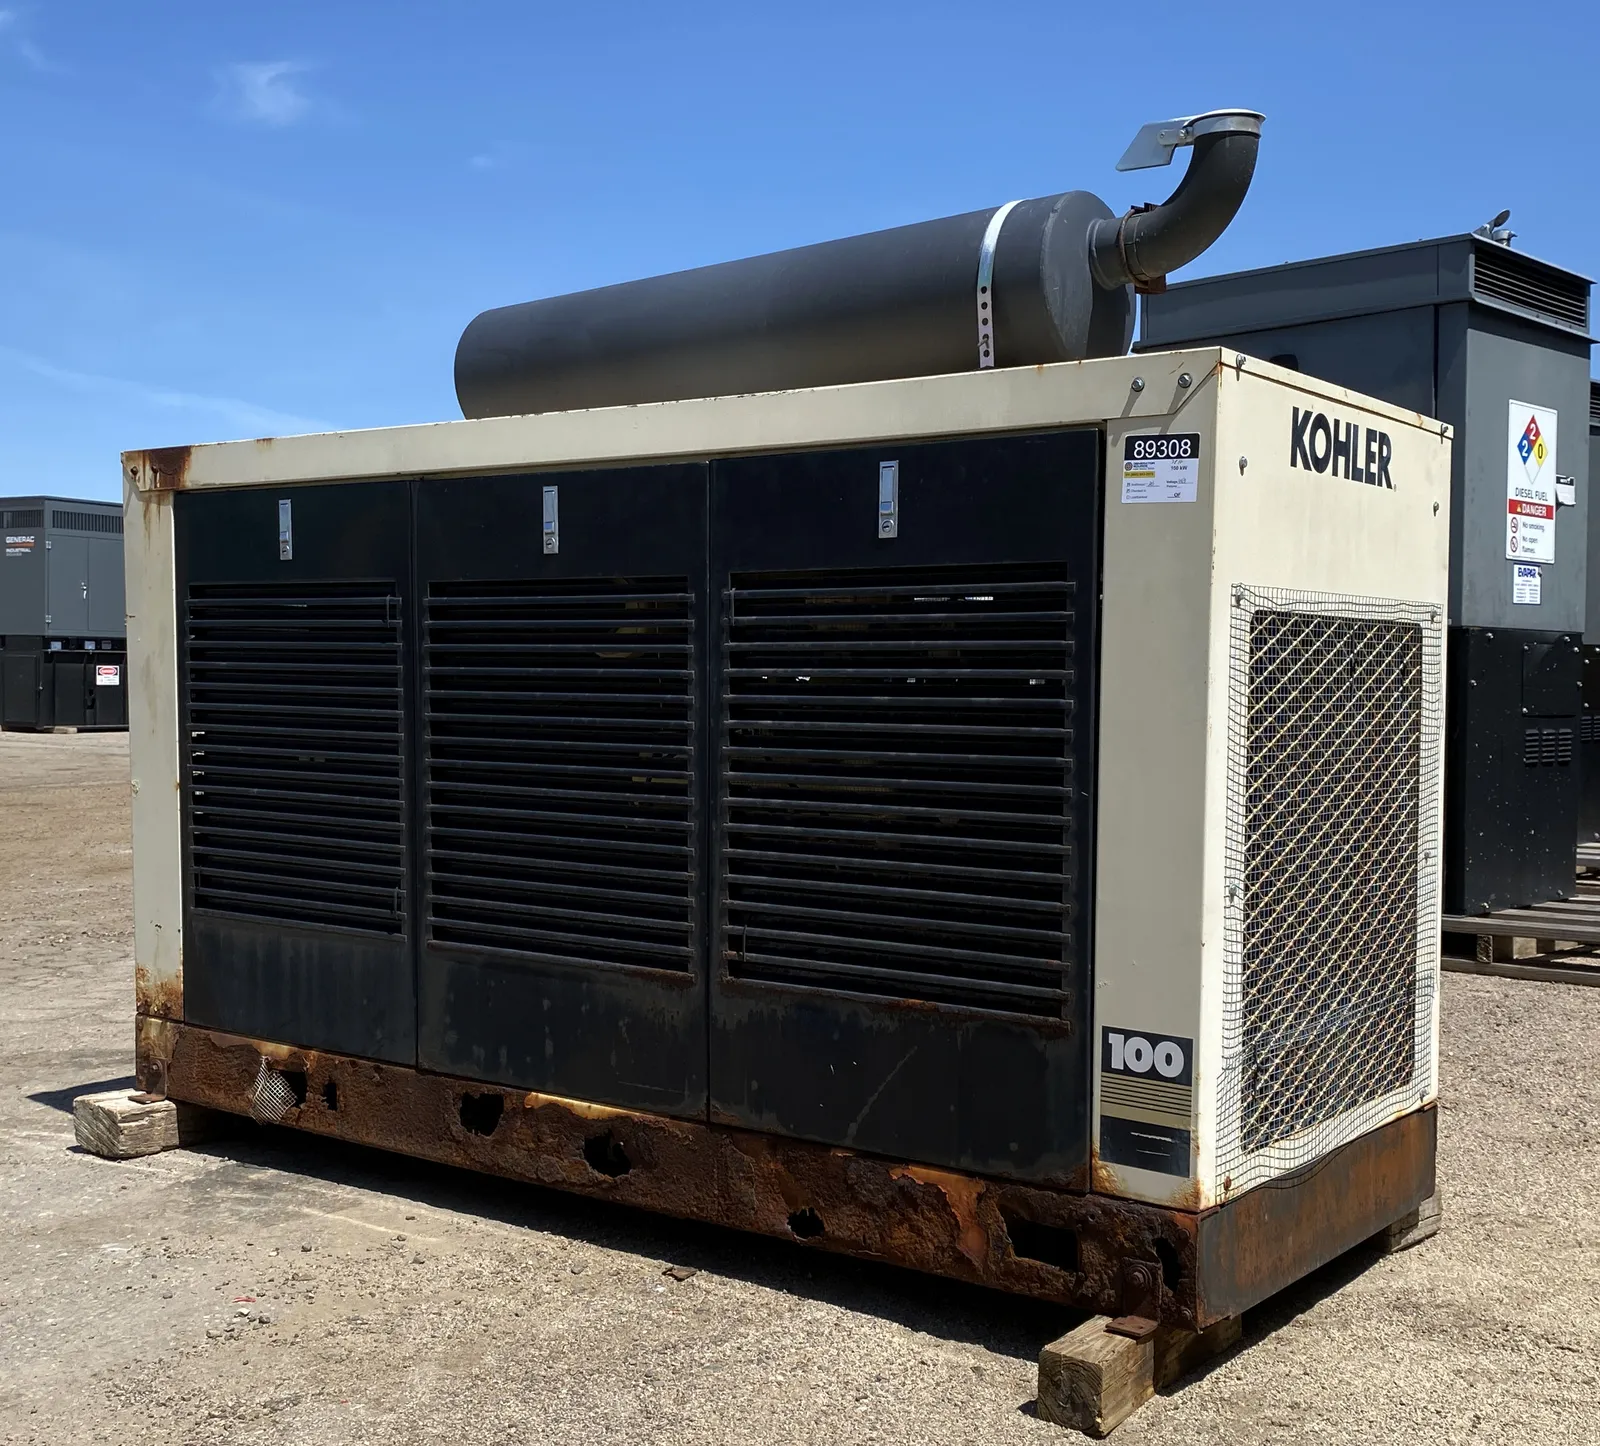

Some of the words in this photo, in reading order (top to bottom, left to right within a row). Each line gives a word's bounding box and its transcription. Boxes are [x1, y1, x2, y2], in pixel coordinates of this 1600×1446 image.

[1529, 423, 1536, 440] 2
[1133, 439, 1191, 458] 89308
[1290, 406, 1393, 490] KOHLER
[1521, 440, 1528, 457] 2
[1537, 443, 1544, 459] 0
[1515, 487, 1533, 499] DIESEL
[1535, 490, 1548, 501] FUEL
[1522, 503, 1547, 517] DANGER
[1108, 1032, 1185, 1078] 100
